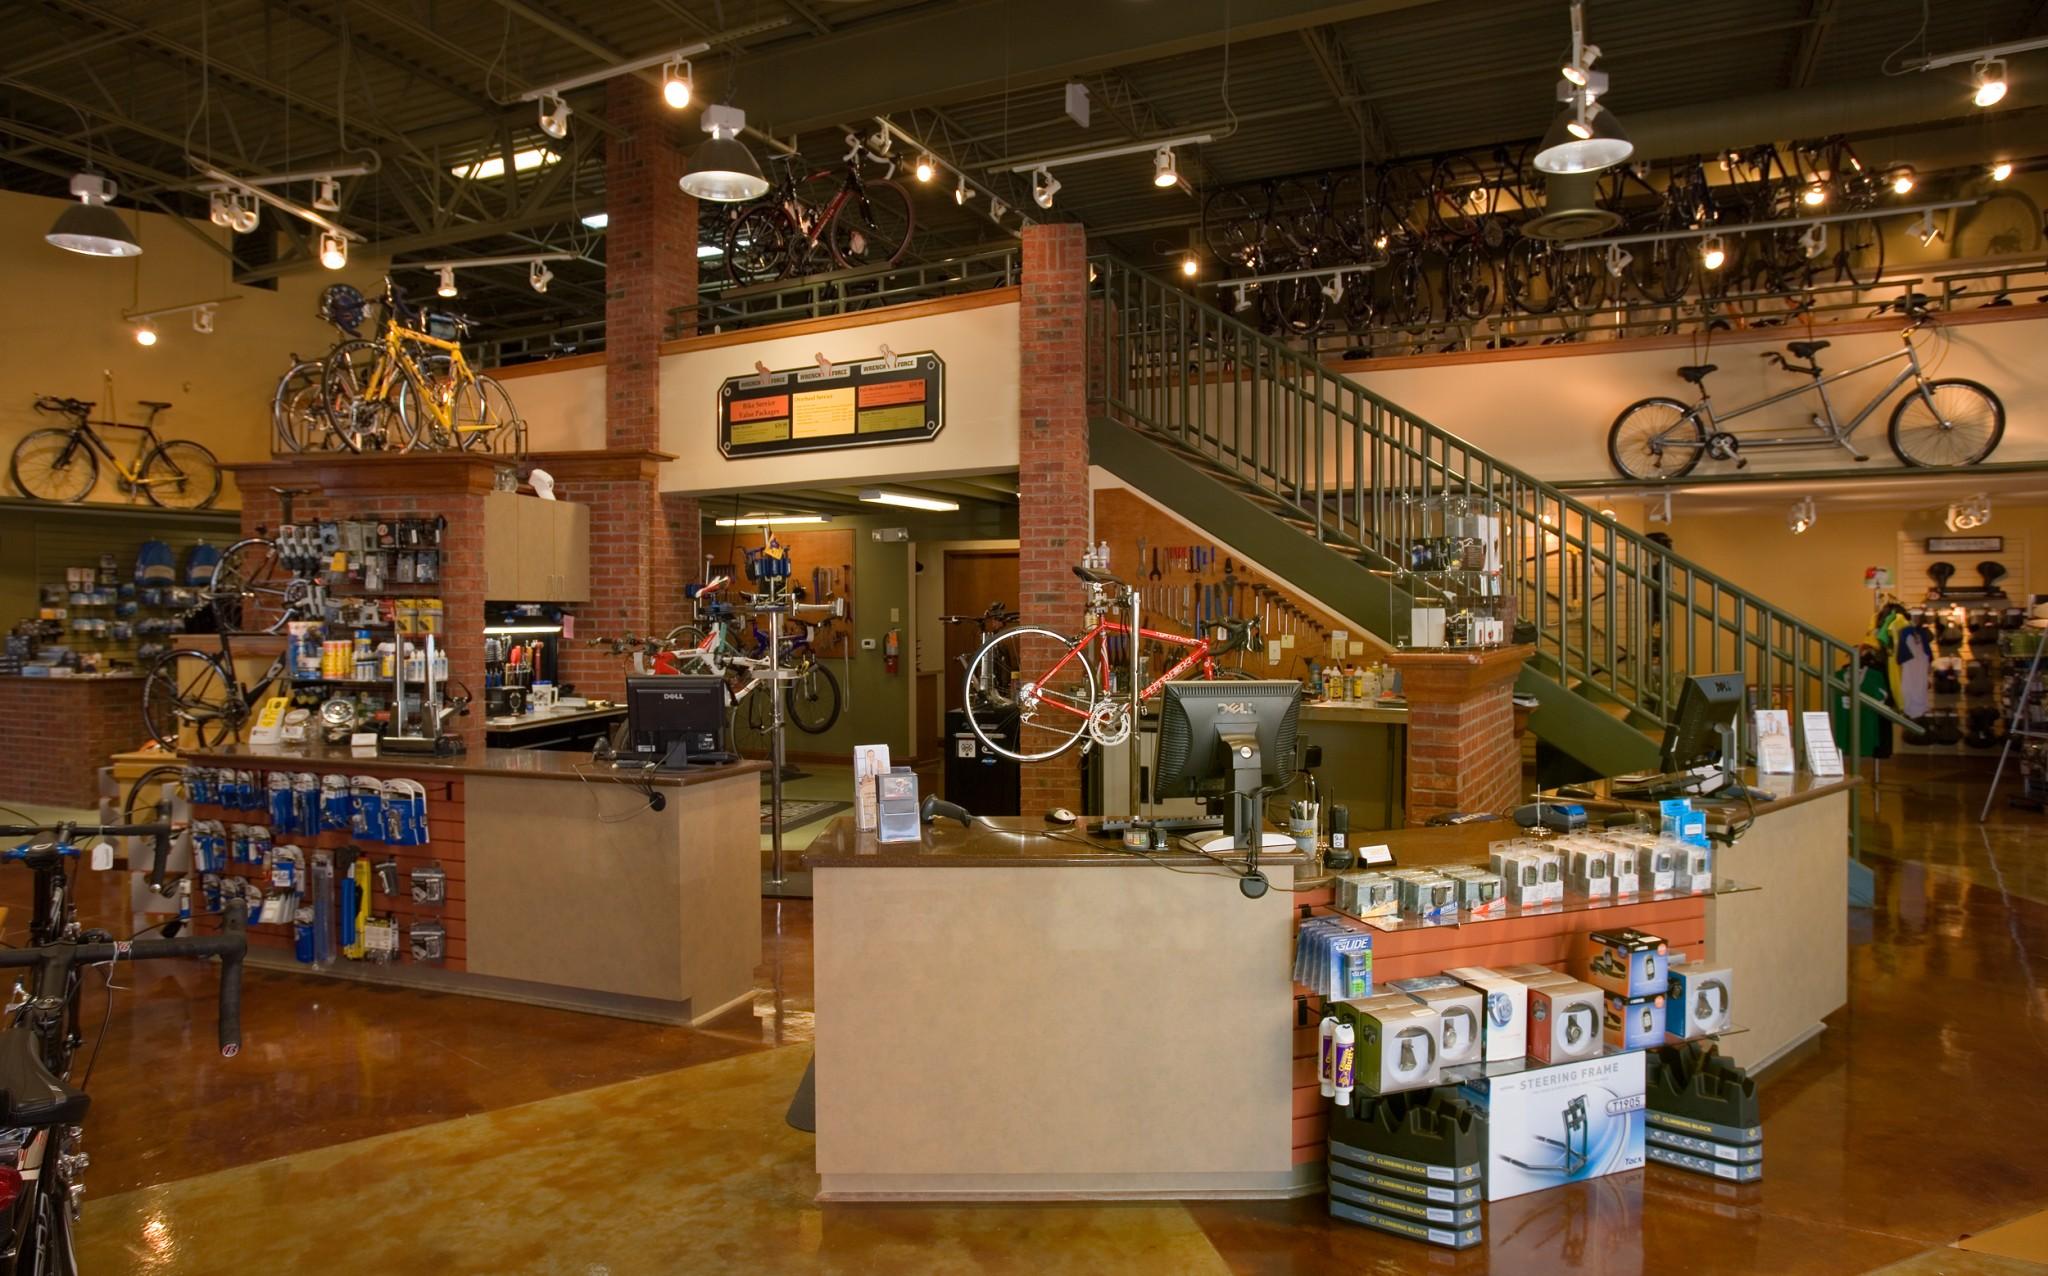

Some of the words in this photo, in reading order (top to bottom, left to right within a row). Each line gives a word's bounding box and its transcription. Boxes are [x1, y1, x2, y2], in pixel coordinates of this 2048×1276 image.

[799, 371, 822, 380] WRENCH
[831, 368, 848, 376] FORCE
[863, 364, 886, 372] WRENCH
[756, 400, 776, 408] Service
[755, 408, 780, 417] Packages
[1217, 702, 1257, 714] DELL
[1520, 1070, 1578, 1090] STEERING
[1581, 1062, 1620, 1078] FRAME
[1612, 1096, 1641, 1112] T1905
[1662, 1116, 1691, 1128] CLIMBING
[1691, 1122, 1713, 1133] BLOCK
[1376, 1158, 1406, 1170] CLIMBING
[1406, 1165, 1426, 1174] BLOCK
[1376, 1179, 1406, 1191] CLIMBING
[1406, 1186, 1427, 1195] BLOCK
[1377, 1199, 1407, 1211] CLIMBING
[1406, 1206, 1427, 1216] BLOCK
[1378, 1219, 1408, 1231] CLIMBING
[1407, 1226, 1428, 1236] BLOCK
